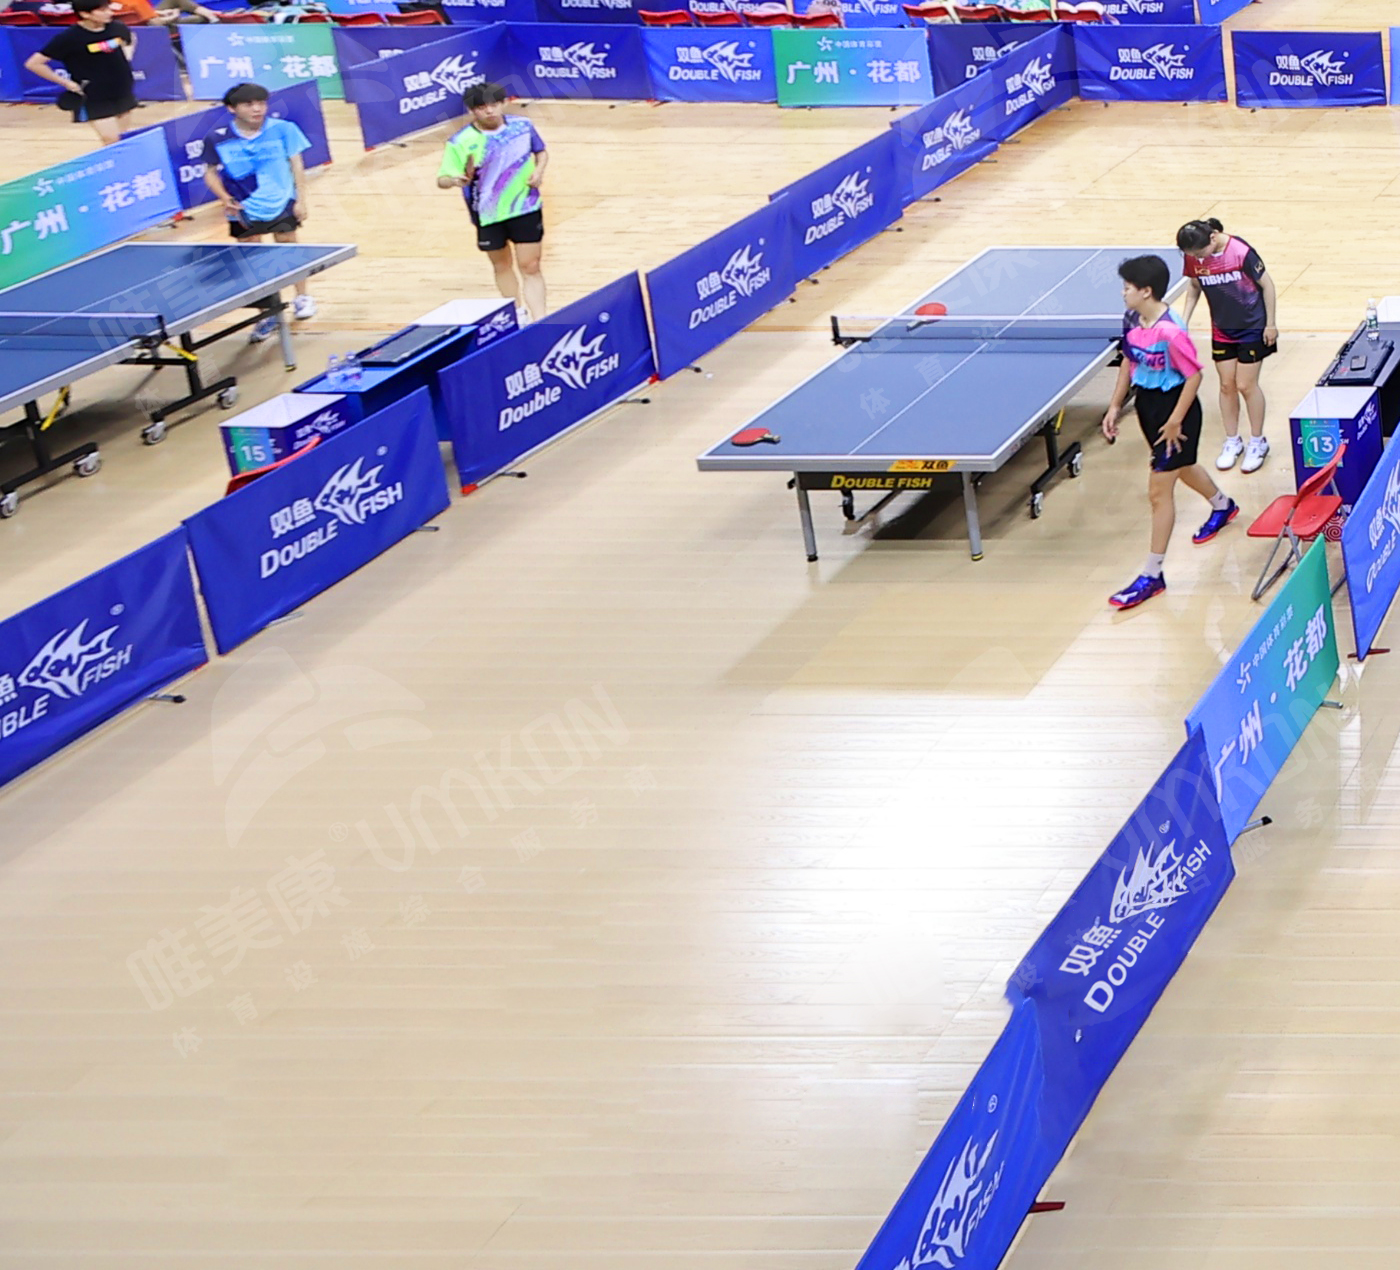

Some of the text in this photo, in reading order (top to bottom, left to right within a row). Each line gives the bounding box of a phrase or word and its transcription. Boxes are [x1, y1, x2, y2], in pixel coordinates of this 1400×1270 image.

[732, 69, 762, 81] FISH
[786, 60, 922, 85] 广州·花都
[1327, 73, 1354, 87] FISH
[1198, 270, 1243, 287] TIBHAR
[584, 351, 622, 385] FISH
[241, 444, 266, 462] 15
[1309, 435, 1334, 453] 13
[830, 474, 933, 490] DOUBLE FISH
[259, 480, 404, 580] DOUBLE FISH
[80, 644, 134, 692] FISH
[1213, 603, 1329, 805] 广州·花都
[1083, 839, 1213, 1014] DOUBLE FISH
